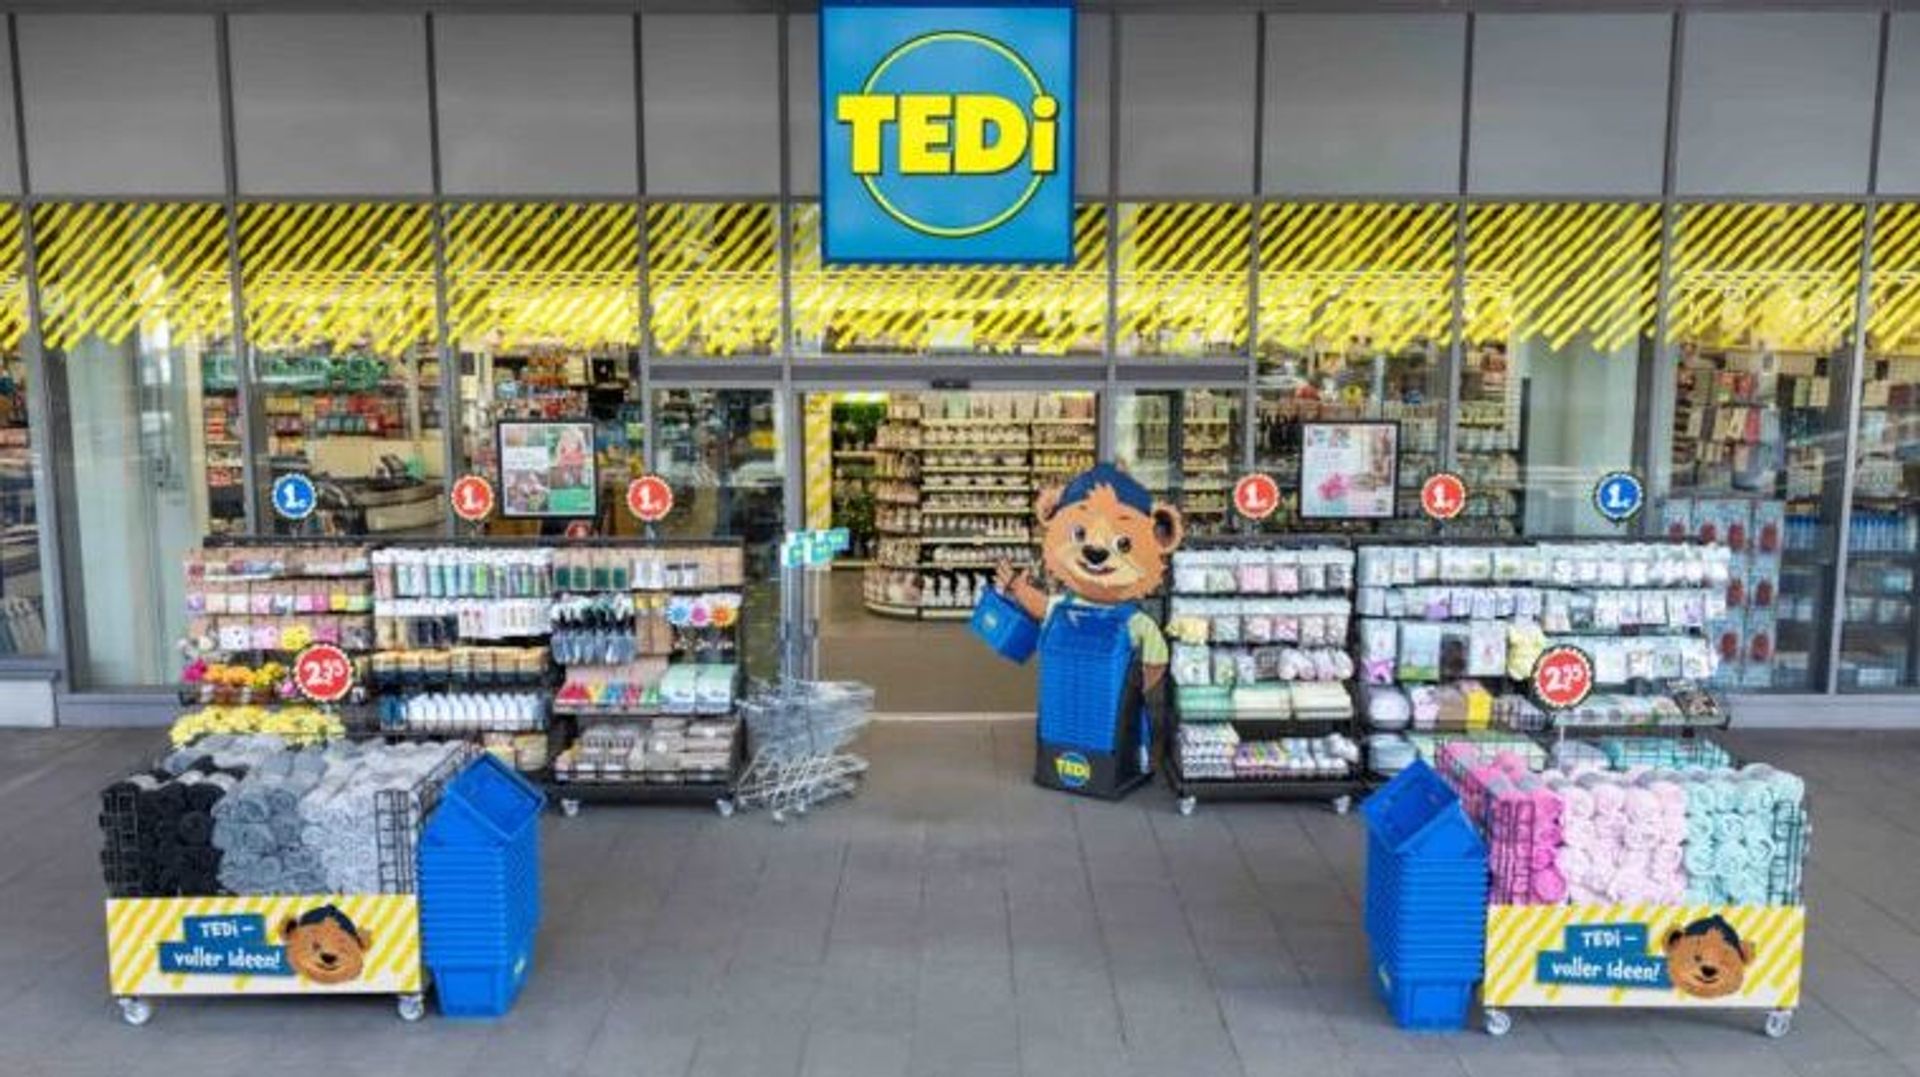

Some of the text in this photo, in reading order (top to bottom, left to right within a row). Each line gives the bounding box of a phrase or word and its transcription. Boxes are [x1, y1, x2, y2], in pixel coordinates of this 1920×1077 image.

[837, 94, 1057, 175] TEDi
[199, 920, 240, 938] TEDi
[1581, 927, 1621, 948] TEDi
[174, 945, 223, 967] voller
[1551, 956, 1661, 982] voller Ideen!
